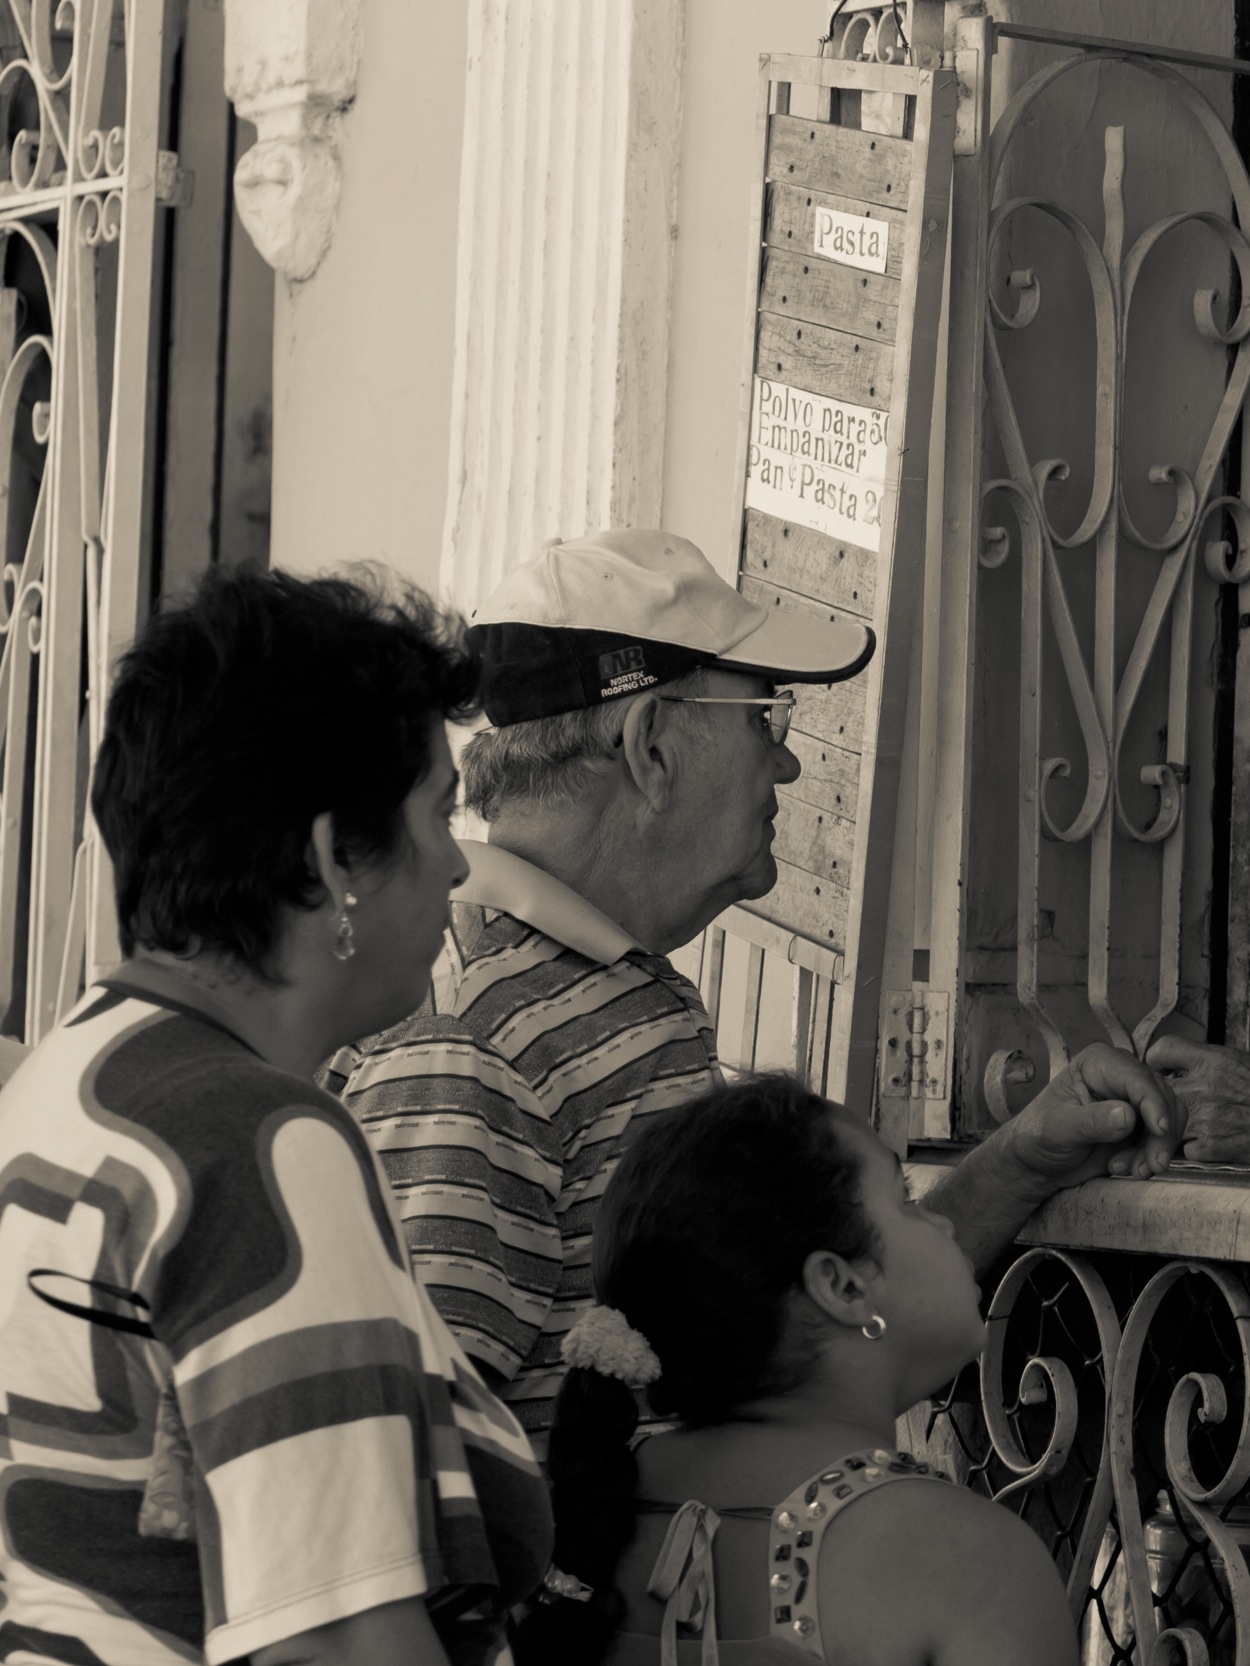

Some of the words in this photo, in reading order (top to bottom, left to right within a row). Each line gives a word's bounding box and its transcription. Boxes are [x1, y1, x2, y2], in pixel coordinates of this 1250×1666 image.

[818, 212, 880, 258] Pasta
[760, 380, 813, 430] Polvo
[822, 407, 867, 446] para
[758, 411, 867, 473] Empanizar
[747, 445, 784, 491] Pan
[799, 463, 858, 521] Pasta
[601, 680, 639, 698] ROOFING
[610, 670, 644, 687] NORTEX
